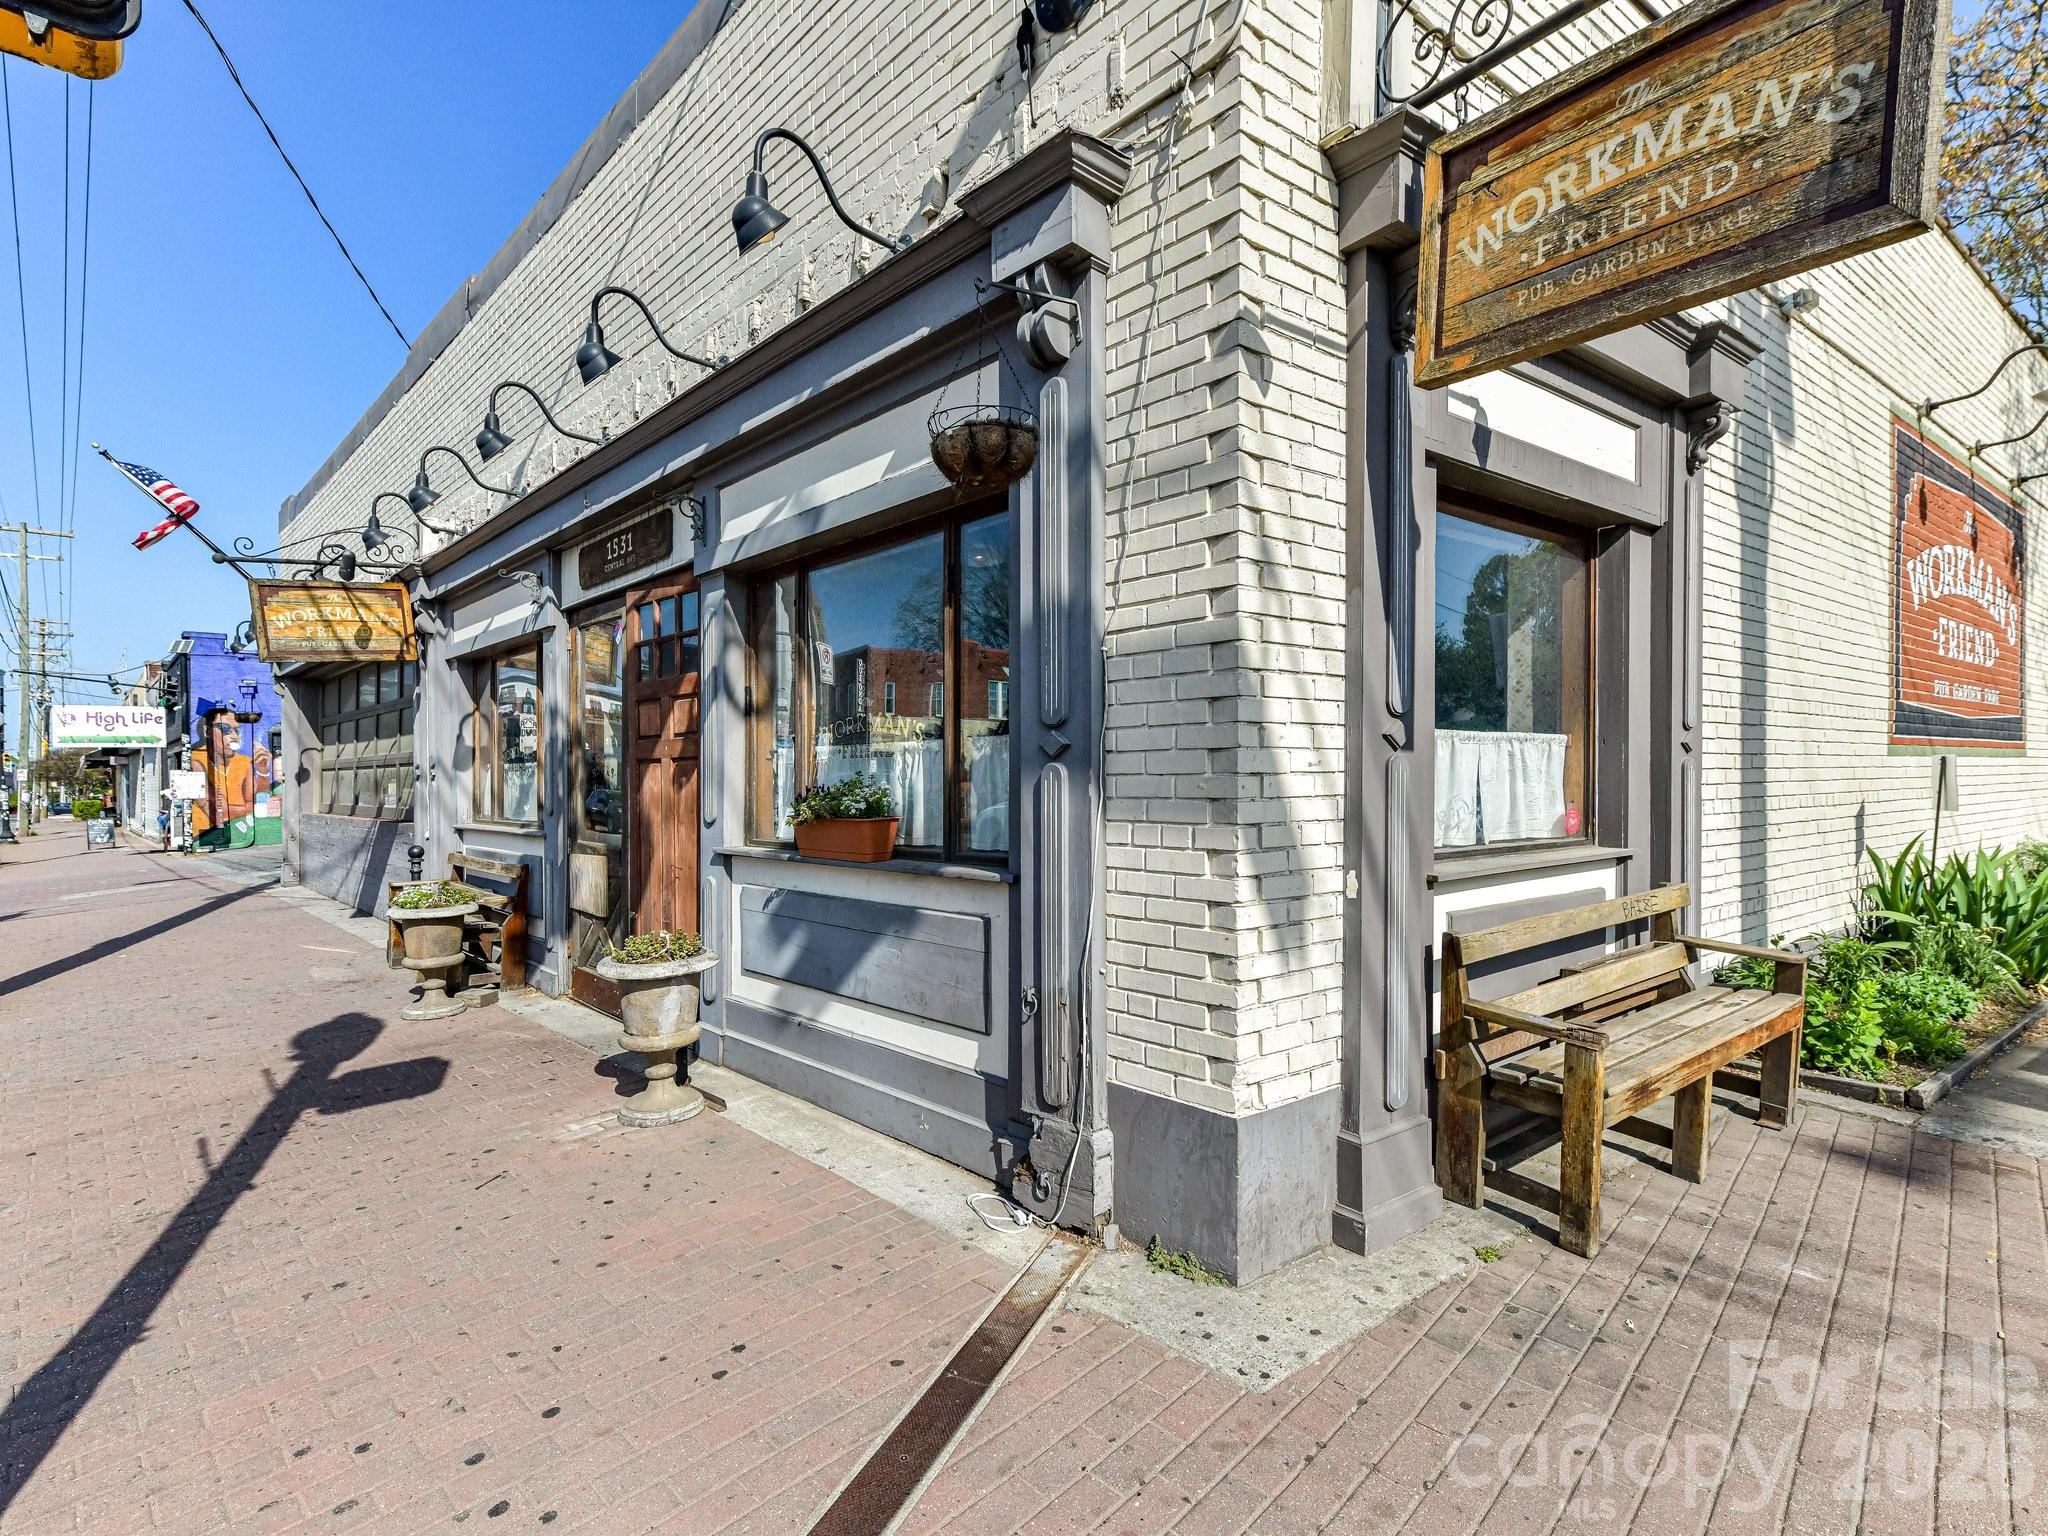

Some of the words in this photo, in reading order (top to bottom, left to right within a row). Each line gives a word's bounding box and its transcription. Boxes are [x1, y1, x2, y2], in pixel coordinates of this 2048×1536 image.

[1612, 77, 1662, 119] The
[1456, 61, 1876, 269] WORKMAN'S
[606, 532, 633, 560] 1531
[1906, 544, 2018, 647] WORKMAN'S
[273, 607, 398, 629] WORKMAN'S
[86, 711, 129, 732] High
[132, 711, 163, 725] Life
